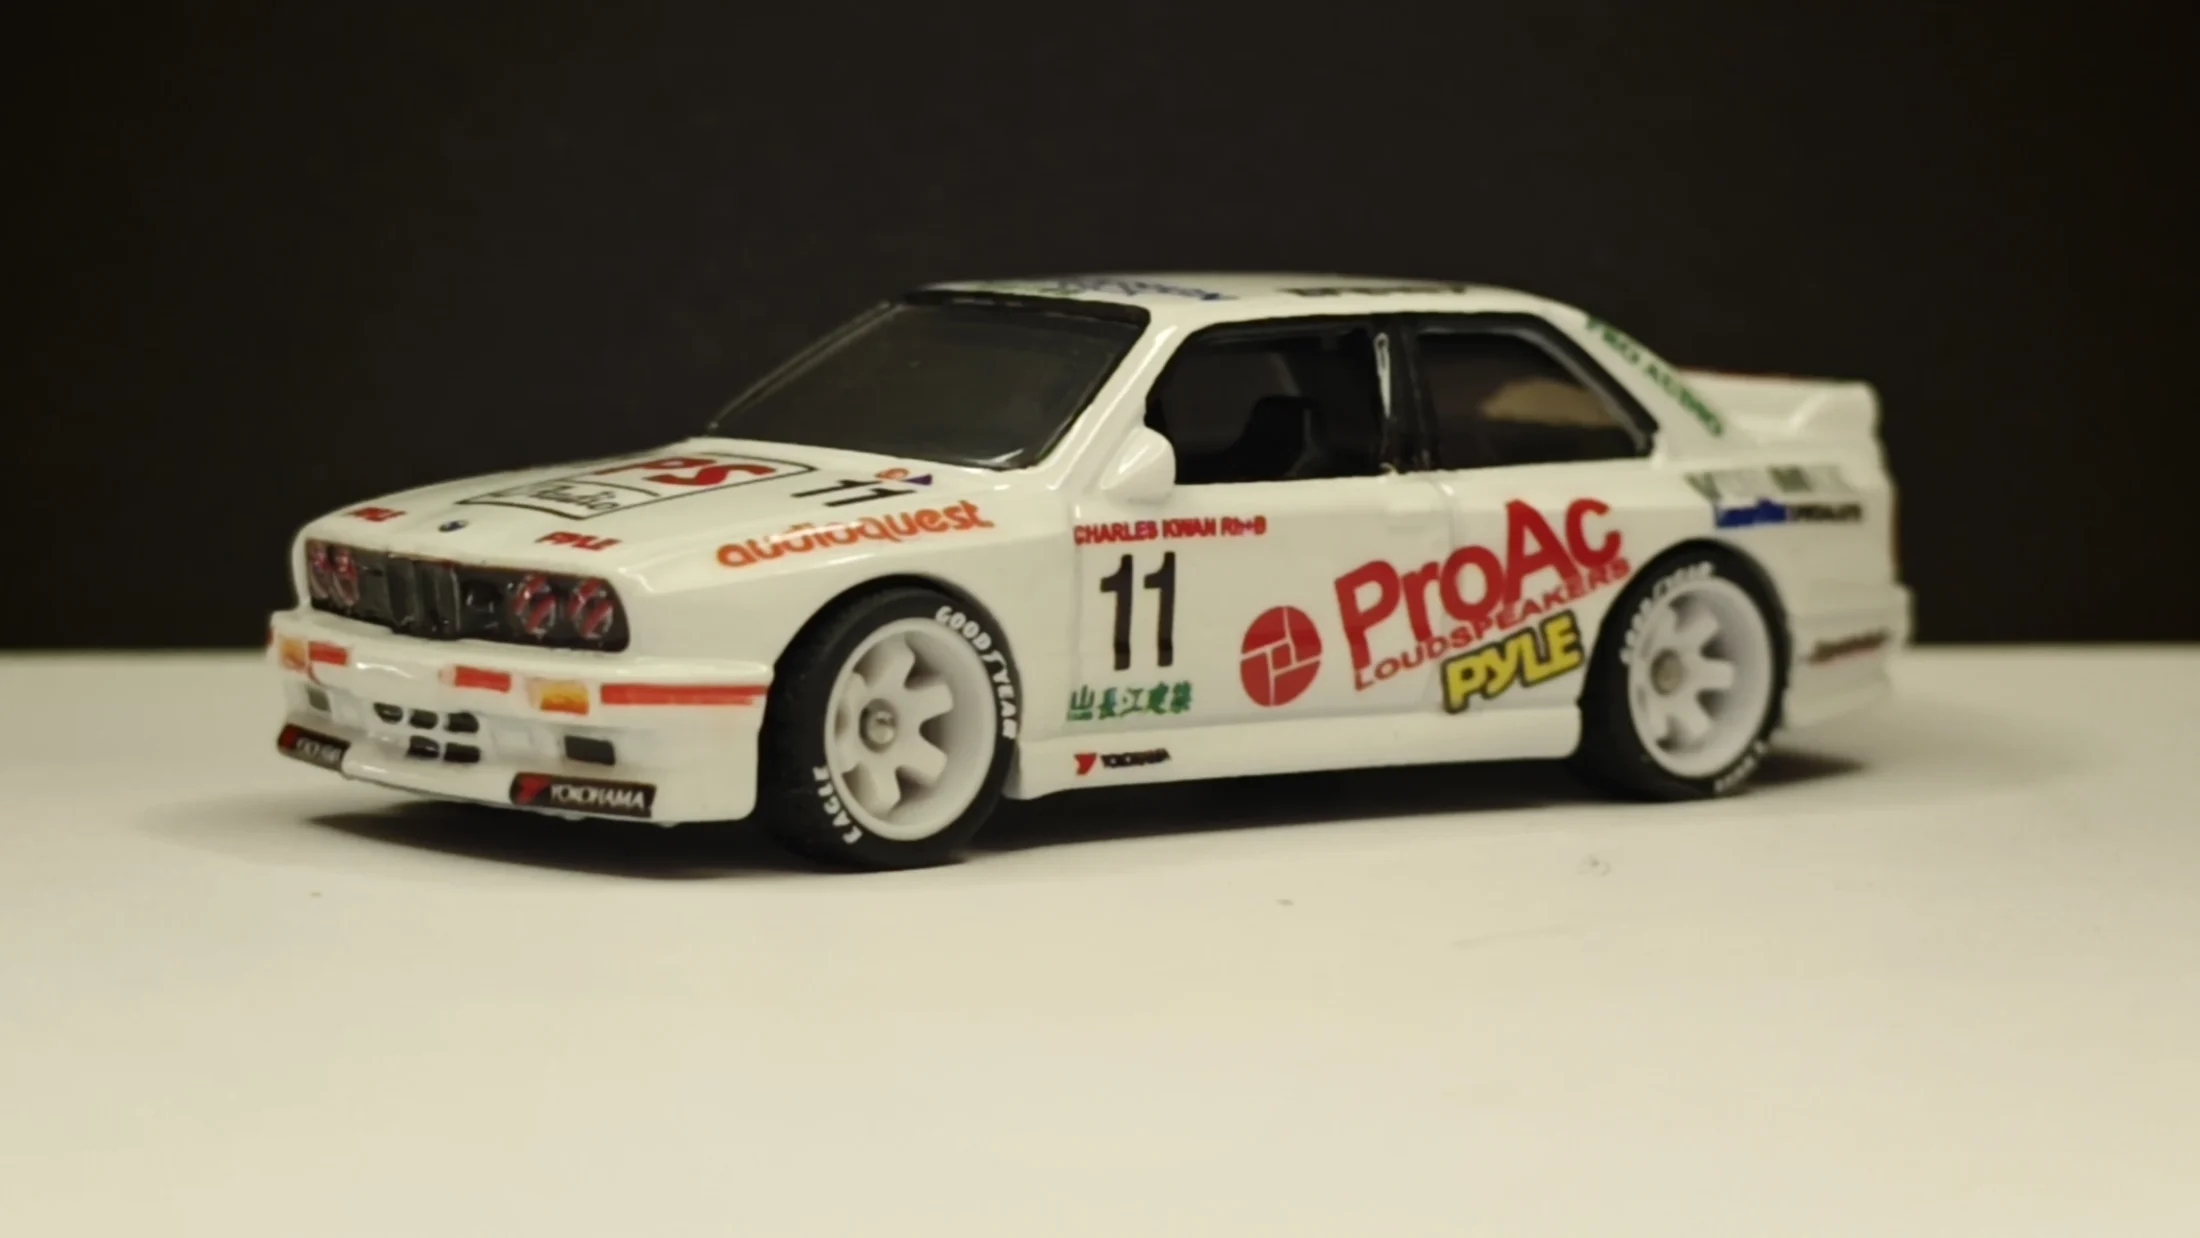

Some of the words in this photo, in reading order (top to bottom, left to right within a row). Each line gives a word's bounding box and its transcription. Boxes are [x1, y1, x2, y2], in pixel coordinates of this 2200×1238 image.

[716, 500, 995, 567] audioquest
[790, 479, 917, 508] 11
[1099, 551, 1176, 670] 11
[1354, 556, 1632, 693] LOUDSPEAKERS
[1441, 607, 1585, 715] PYLE
[551, 783, 646, 811] YOKOHAMA
[812, 764, 863, 845] EAGLE
